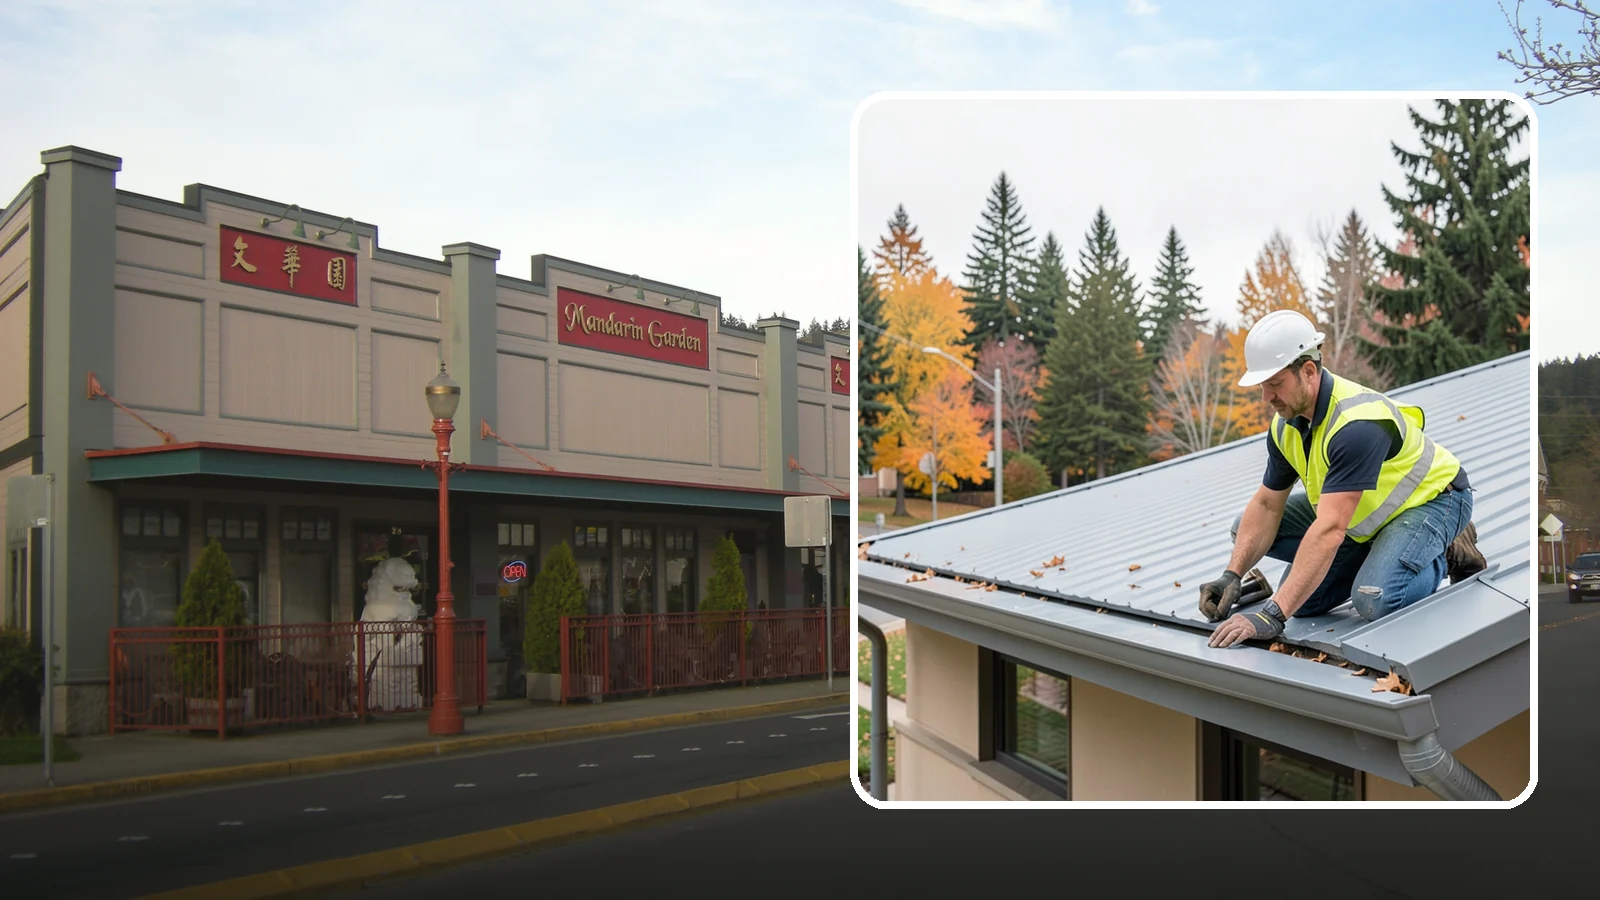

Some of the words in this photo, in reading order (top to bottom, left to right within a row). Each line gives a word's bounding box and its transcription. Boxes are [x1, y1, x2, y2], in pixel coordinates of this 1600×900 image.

[230, 235, 347, 291] 文華園
[564, 302, 644, 341] Mandarin
[647, 320, 702, 353] Garden
[503, 565, 527, 578] OPEN
